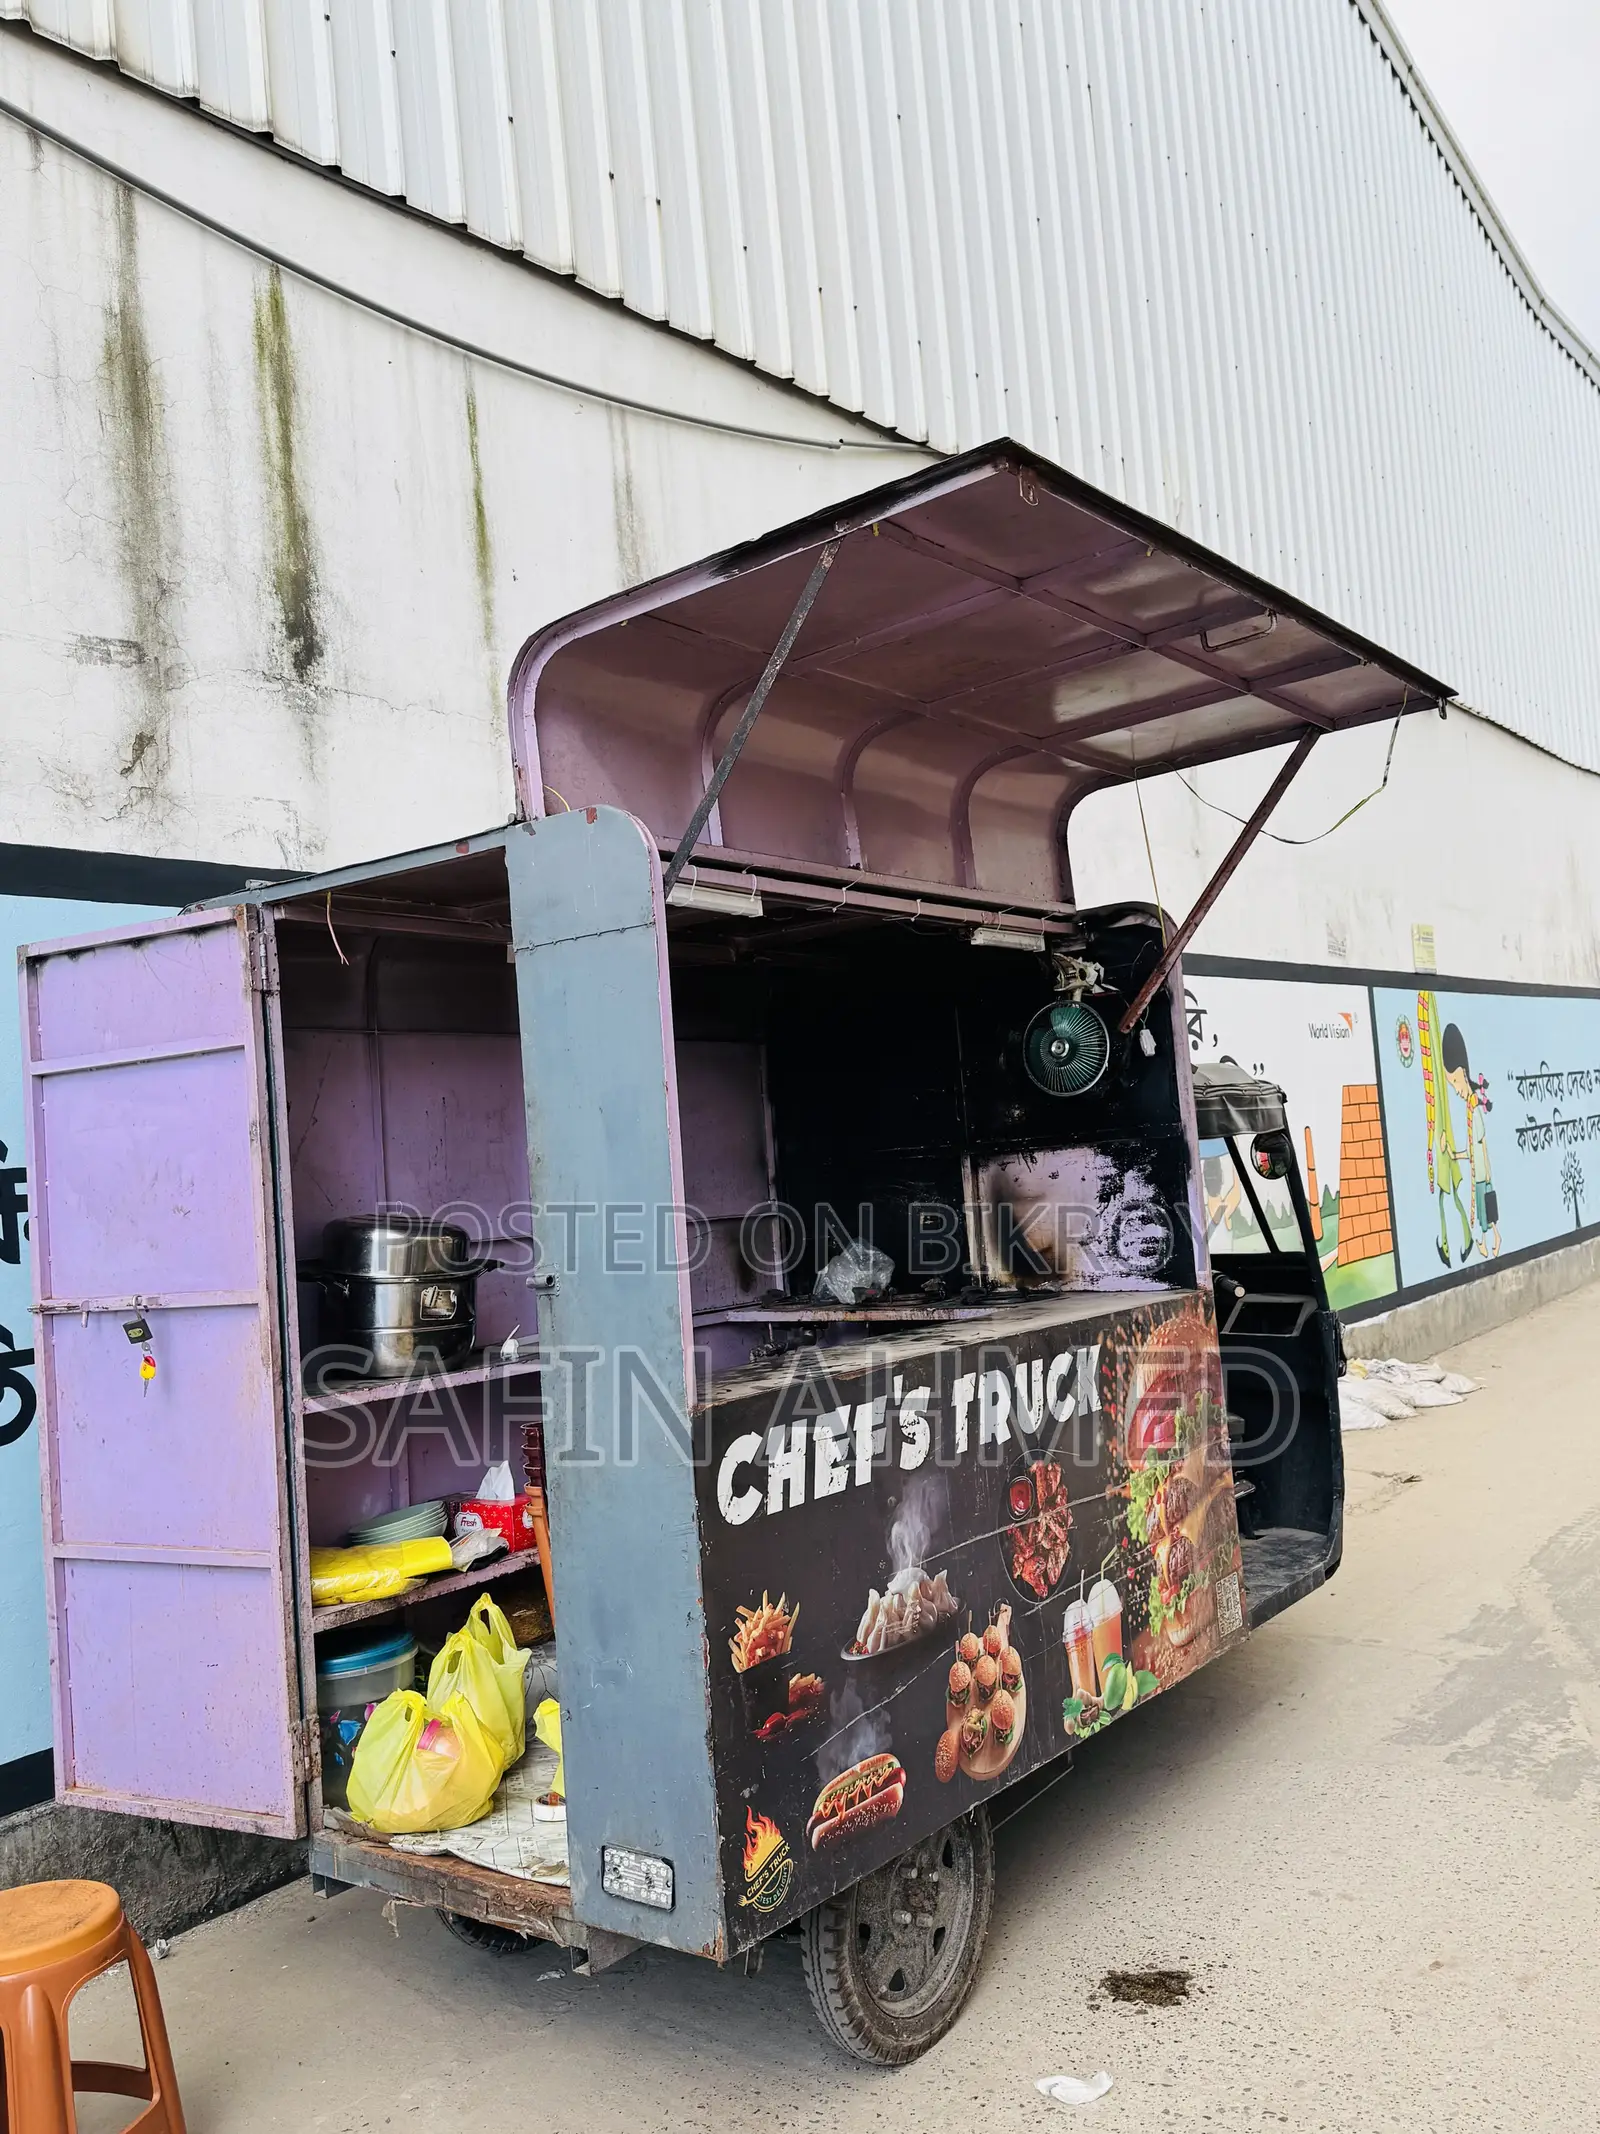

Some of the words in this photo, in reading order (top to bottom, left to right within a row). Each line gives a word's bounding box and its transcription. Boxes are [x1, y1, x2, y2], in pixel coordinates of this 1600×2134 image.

[1308, 1022, 1328, 1039] World
[1328, 1022, 1350, 1039] Vision
[717, 1375, 931, 1526] CHEF'S
[953, 1344, 1103, 1454] TRUCK
[460, 1516, 477, 1527] Fresh
[746, 1868, 770, 1897] CHEF'S
[768, 1842, 790, 1872] TRUCK
